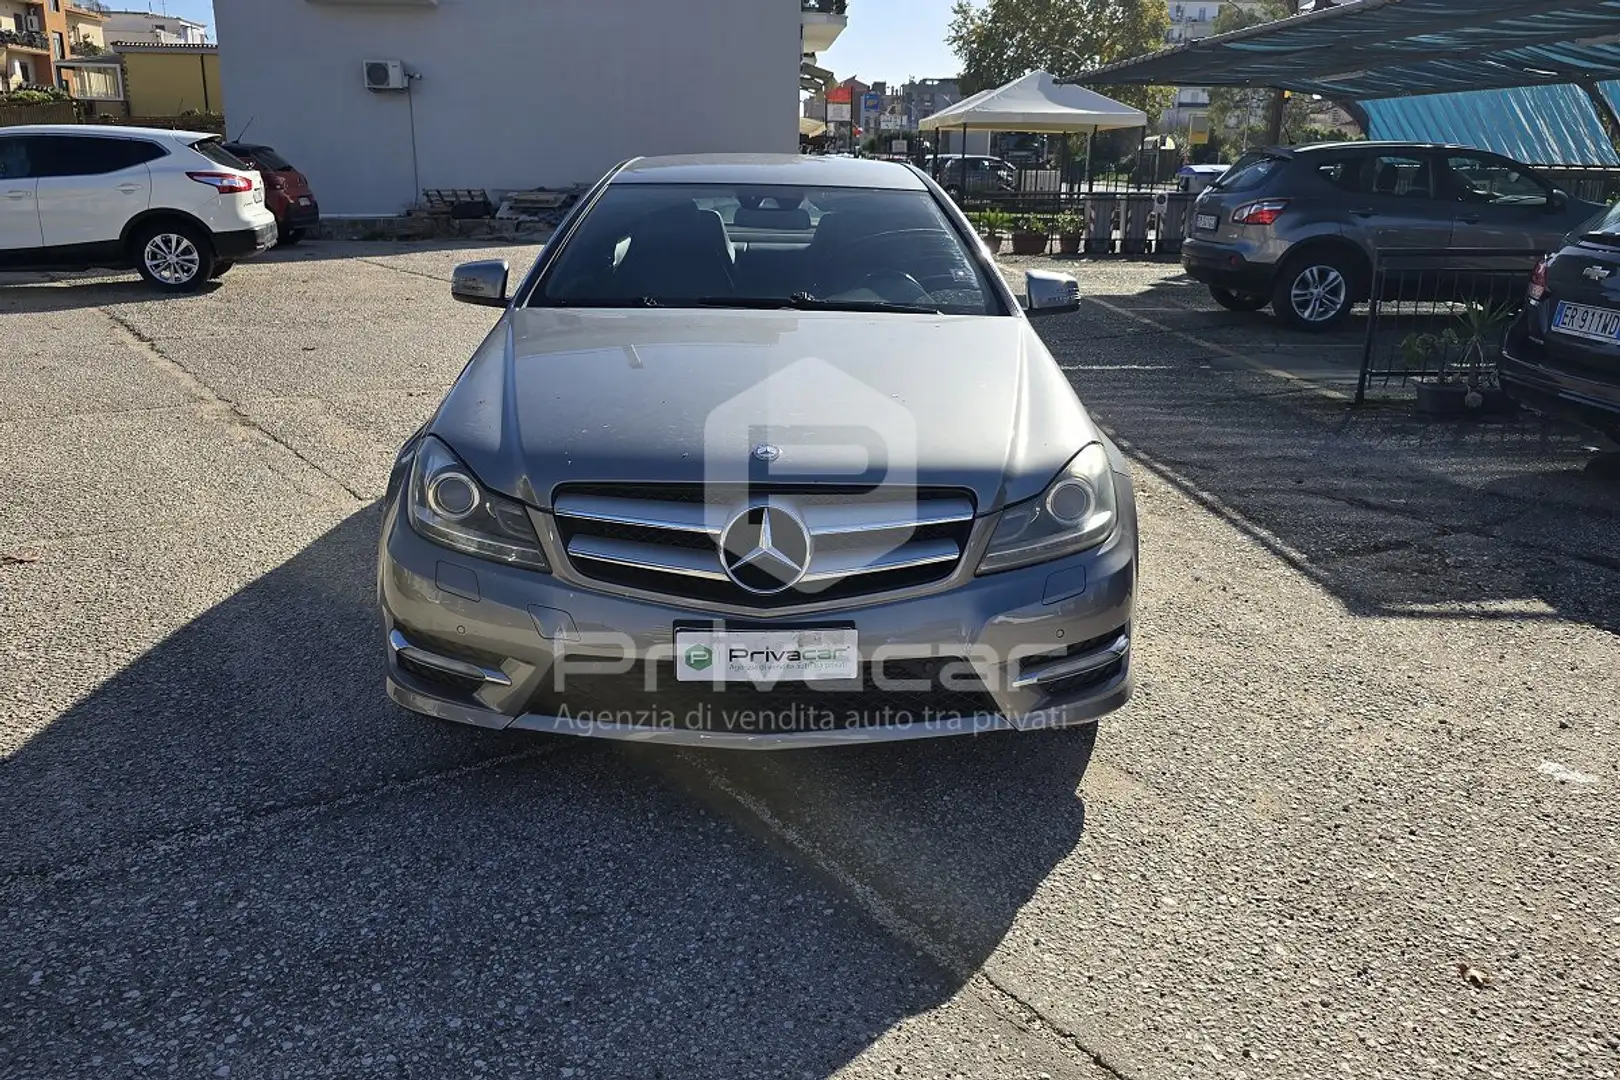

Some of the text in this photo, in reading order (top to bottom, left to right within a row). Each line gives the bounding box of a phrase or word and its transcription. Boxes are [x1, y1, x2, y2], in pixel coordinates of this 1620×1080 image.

[1561, 306, 1620, 335] ER 911WD
[729, 645, 848, 662] Privacar
